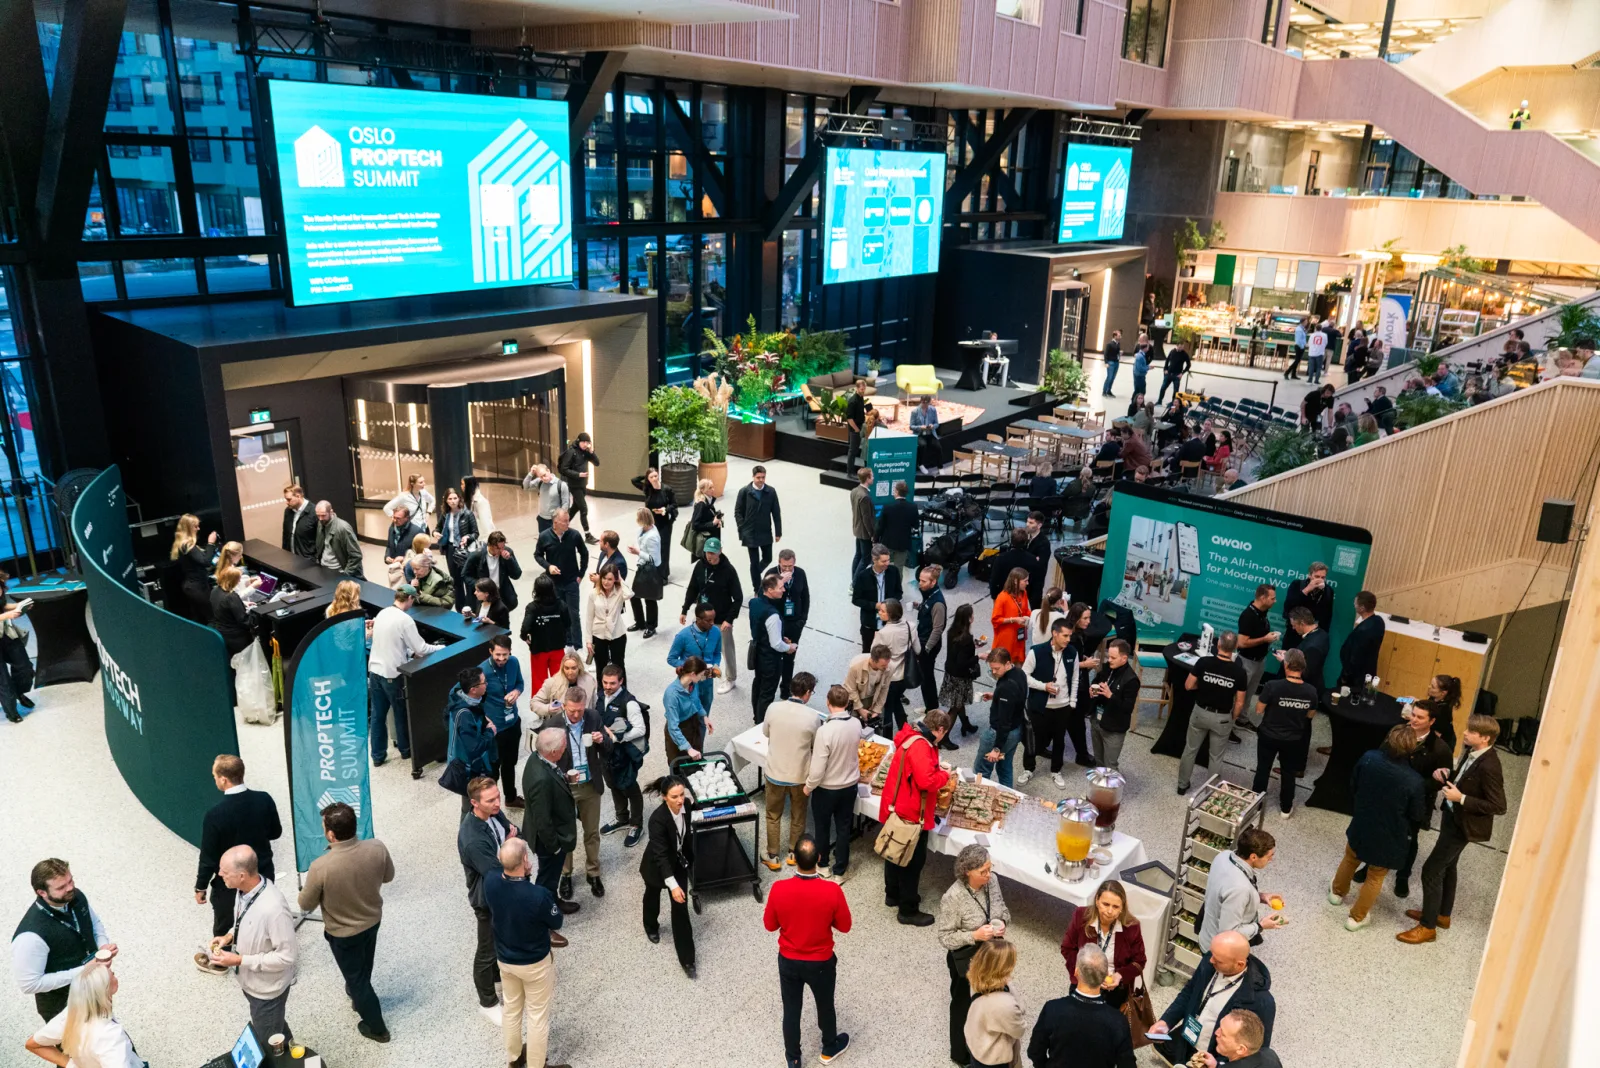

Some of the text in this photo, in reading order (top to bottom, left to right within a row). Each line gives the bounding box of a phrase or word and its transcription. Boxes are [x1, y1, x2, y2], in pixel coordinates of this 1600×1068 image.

[348, 126, 396, 145] OSLO
[350, 147, 443, 167] PROPTECH
[353, 169, 420, 187] SUMMIT
[873, 461, 910, 469] Futureproofing
[1206, 563, 1266, 585] for Modern
[1208, 551, 1229, 563] The
[1230, 557, 1285, 576] All-in-one
[314, 680, 336, 781] PROPTECH
[338, 707, 359, 780] SUMMIT
